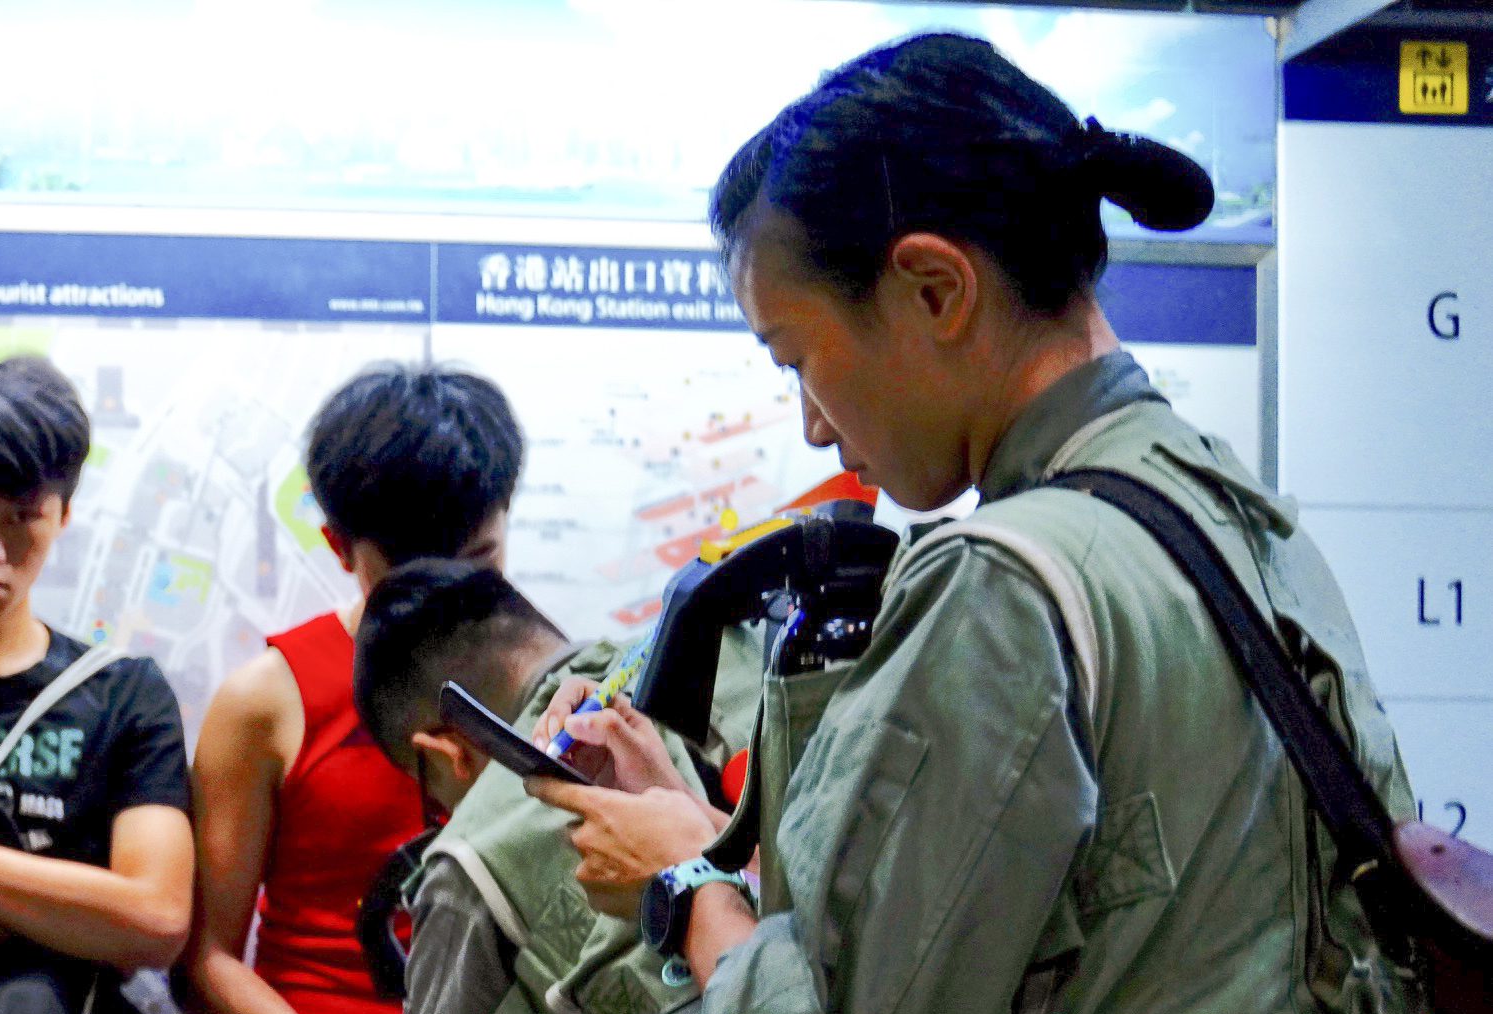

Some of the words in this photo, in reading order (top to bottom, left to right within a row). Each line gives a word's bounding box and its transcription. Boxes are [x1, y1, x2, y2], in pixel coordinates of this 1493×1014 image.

[49, 282, 164, 308] attractions
[475, 291, 534, 323] Hong
[536, 293, 593, 324] Kong
[595, 294, 670, 320] Station
[671, 299, 711, 322] exit
[1427, 291, 1460, 340] G
[1417, 578, 1462, 626] L1
